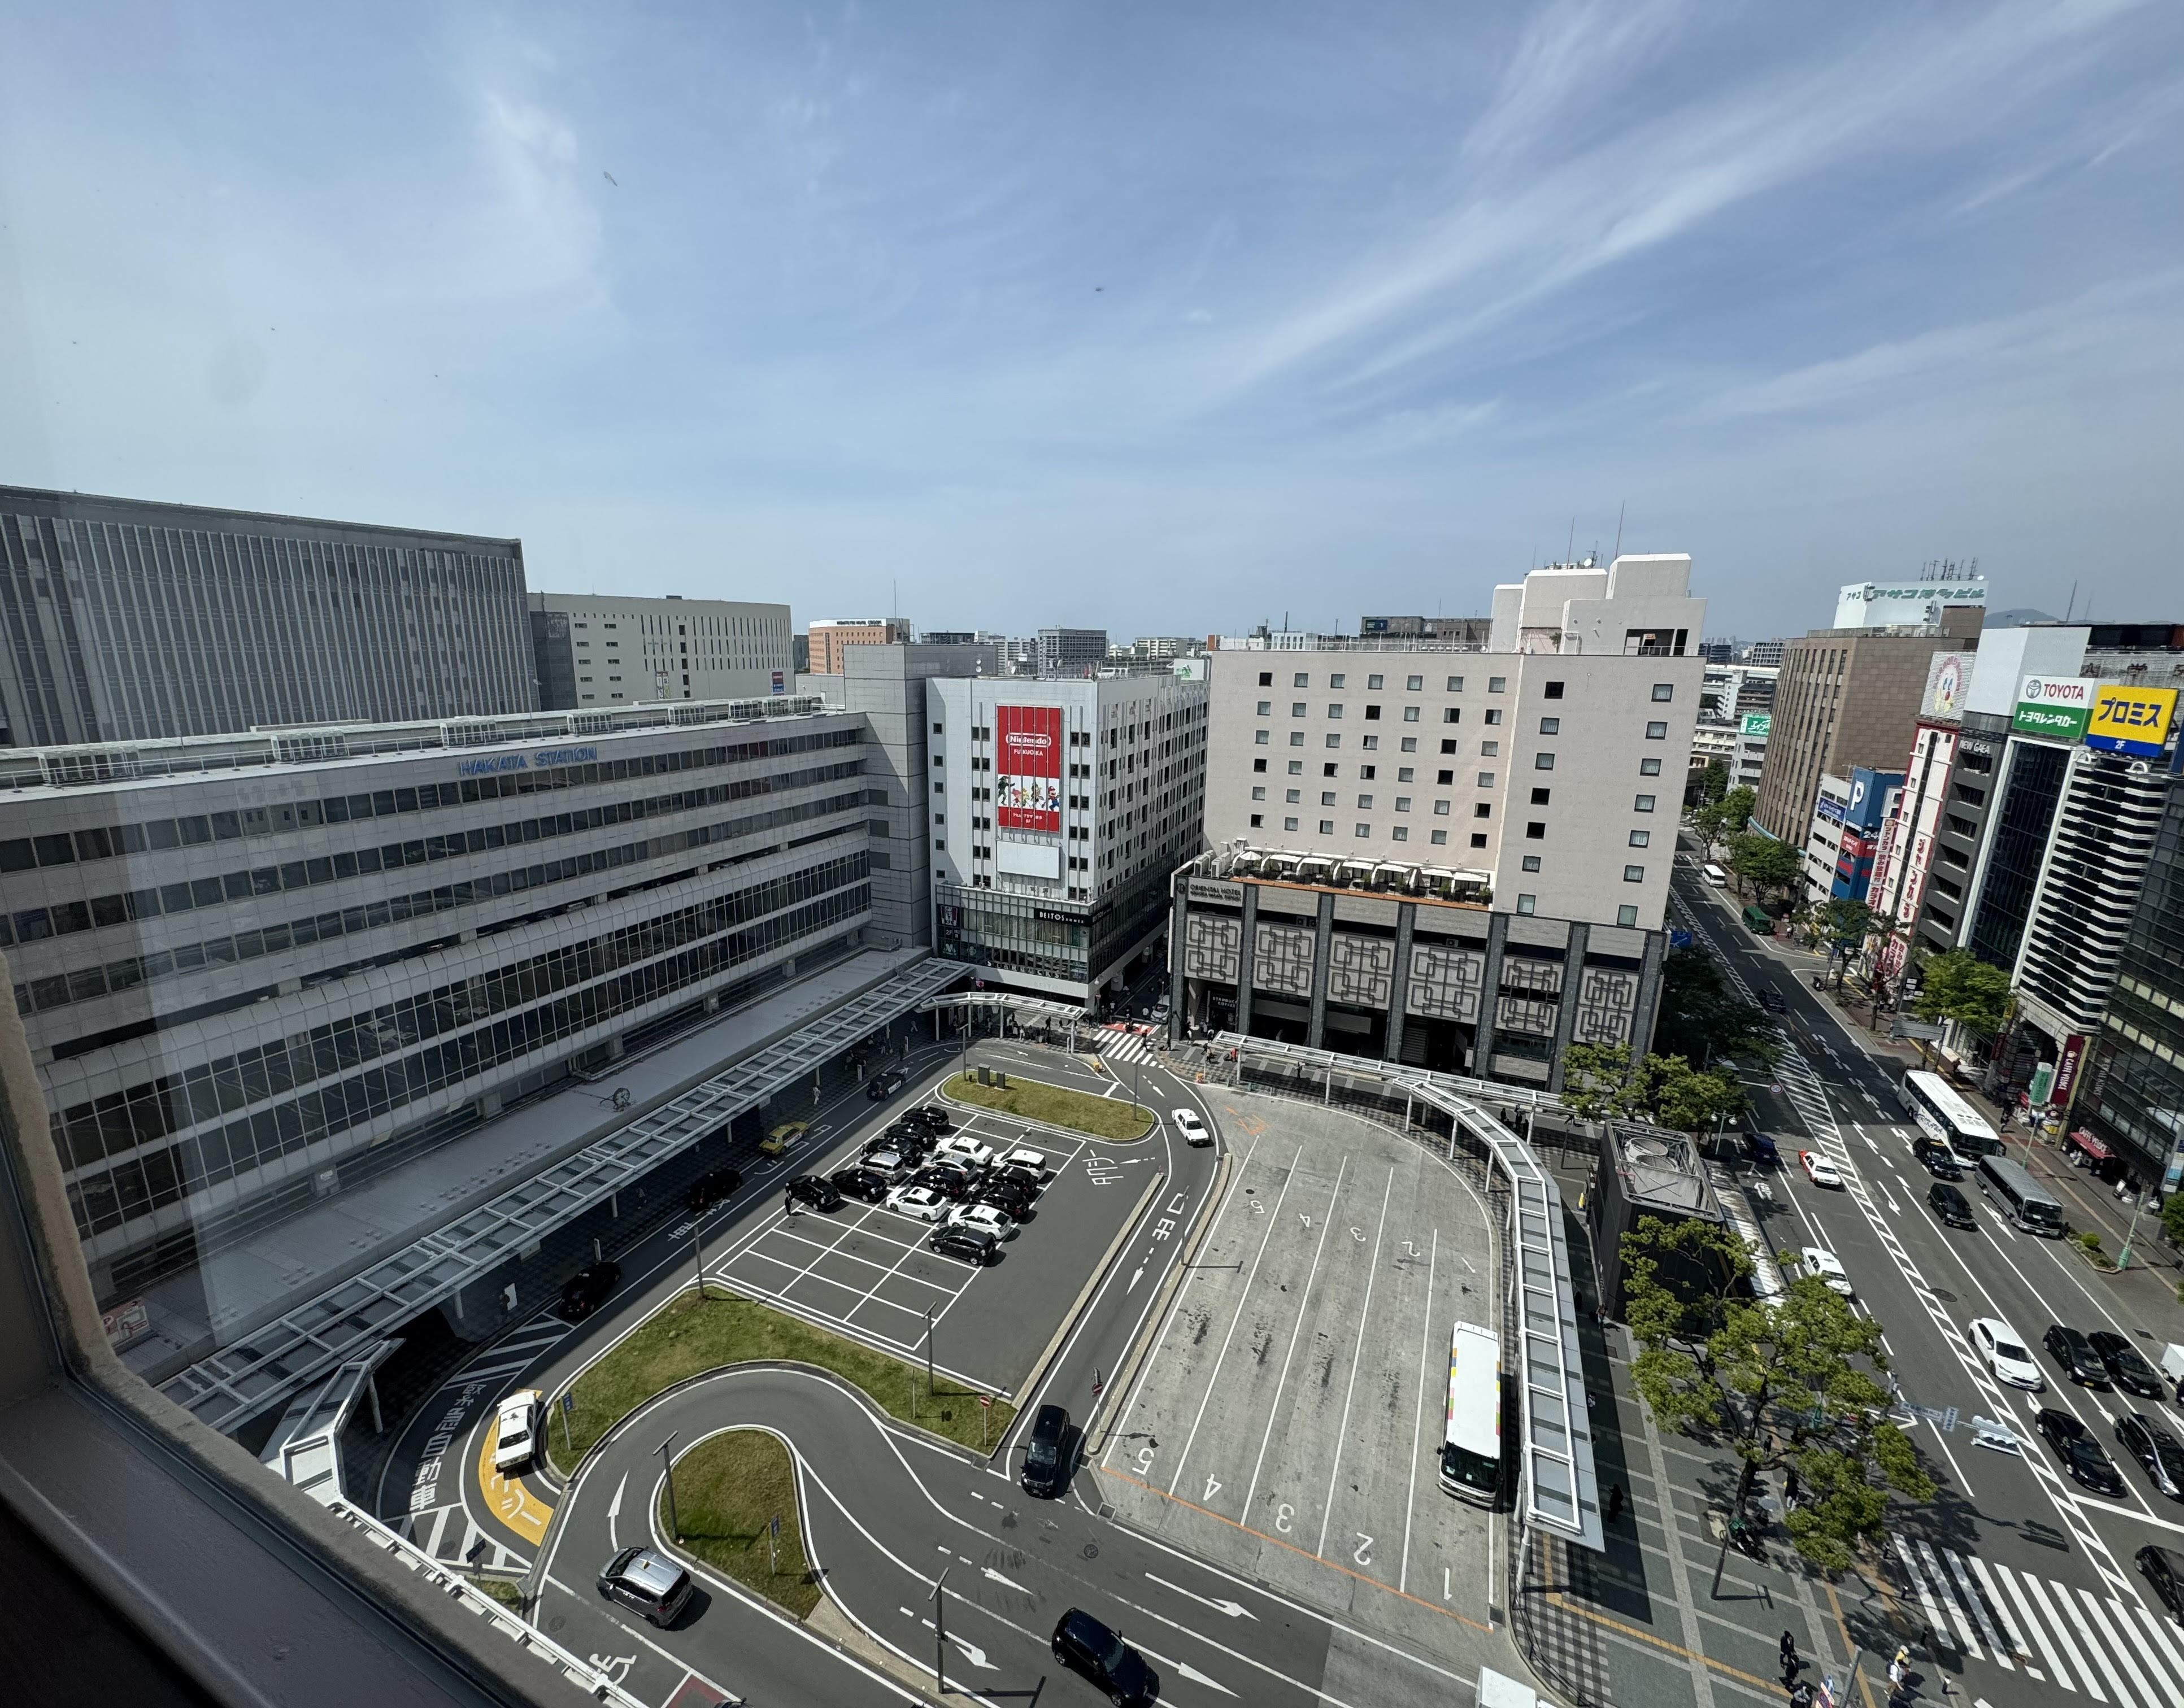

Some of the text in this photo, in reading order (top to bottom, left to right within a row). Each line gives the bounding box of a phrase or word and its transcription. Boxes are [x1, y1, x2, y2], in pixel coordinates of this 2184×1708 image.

[2043, 683, 2084, 700] TOYOTA
[2018, 711, 2078, 728] トヨタレンタカー
[2098, 696, 2163, 728] プロミス
[1010, 734, 1047, 746] Nintendo
[1959, 739, 1974, 750] NEW
[2116, 740, 2127, 750] 2F
[459, 746, 598, 777] HAKATA STATION
[1850, 780, 1864, 811] P
[1863, 830, 1880, 839] 24
[1903, 838, 1926, 919] ジャンカラ
[1039, 911, 1065, 921] DEITOS
[1151, 1192, 1189, 1241] 出口
[1250, 1200, 1265, 1214] 5
[1298, 1212, 1311, 1228] 4
[1350, 1227, 1367, 1243] 3
[1401, 1240, 1421, 1257] 2
[408, 1383, 487, 1512] 緊急自動車
[1132, 1448, 1155, 1475] 5
[1203, 1473, 1222, 1501] 4
[1275, 1503, 1295, 1533] 3
[1354, 1531, 1374, 1566] 2
[1443, 1567, 1453, 1601] 1
